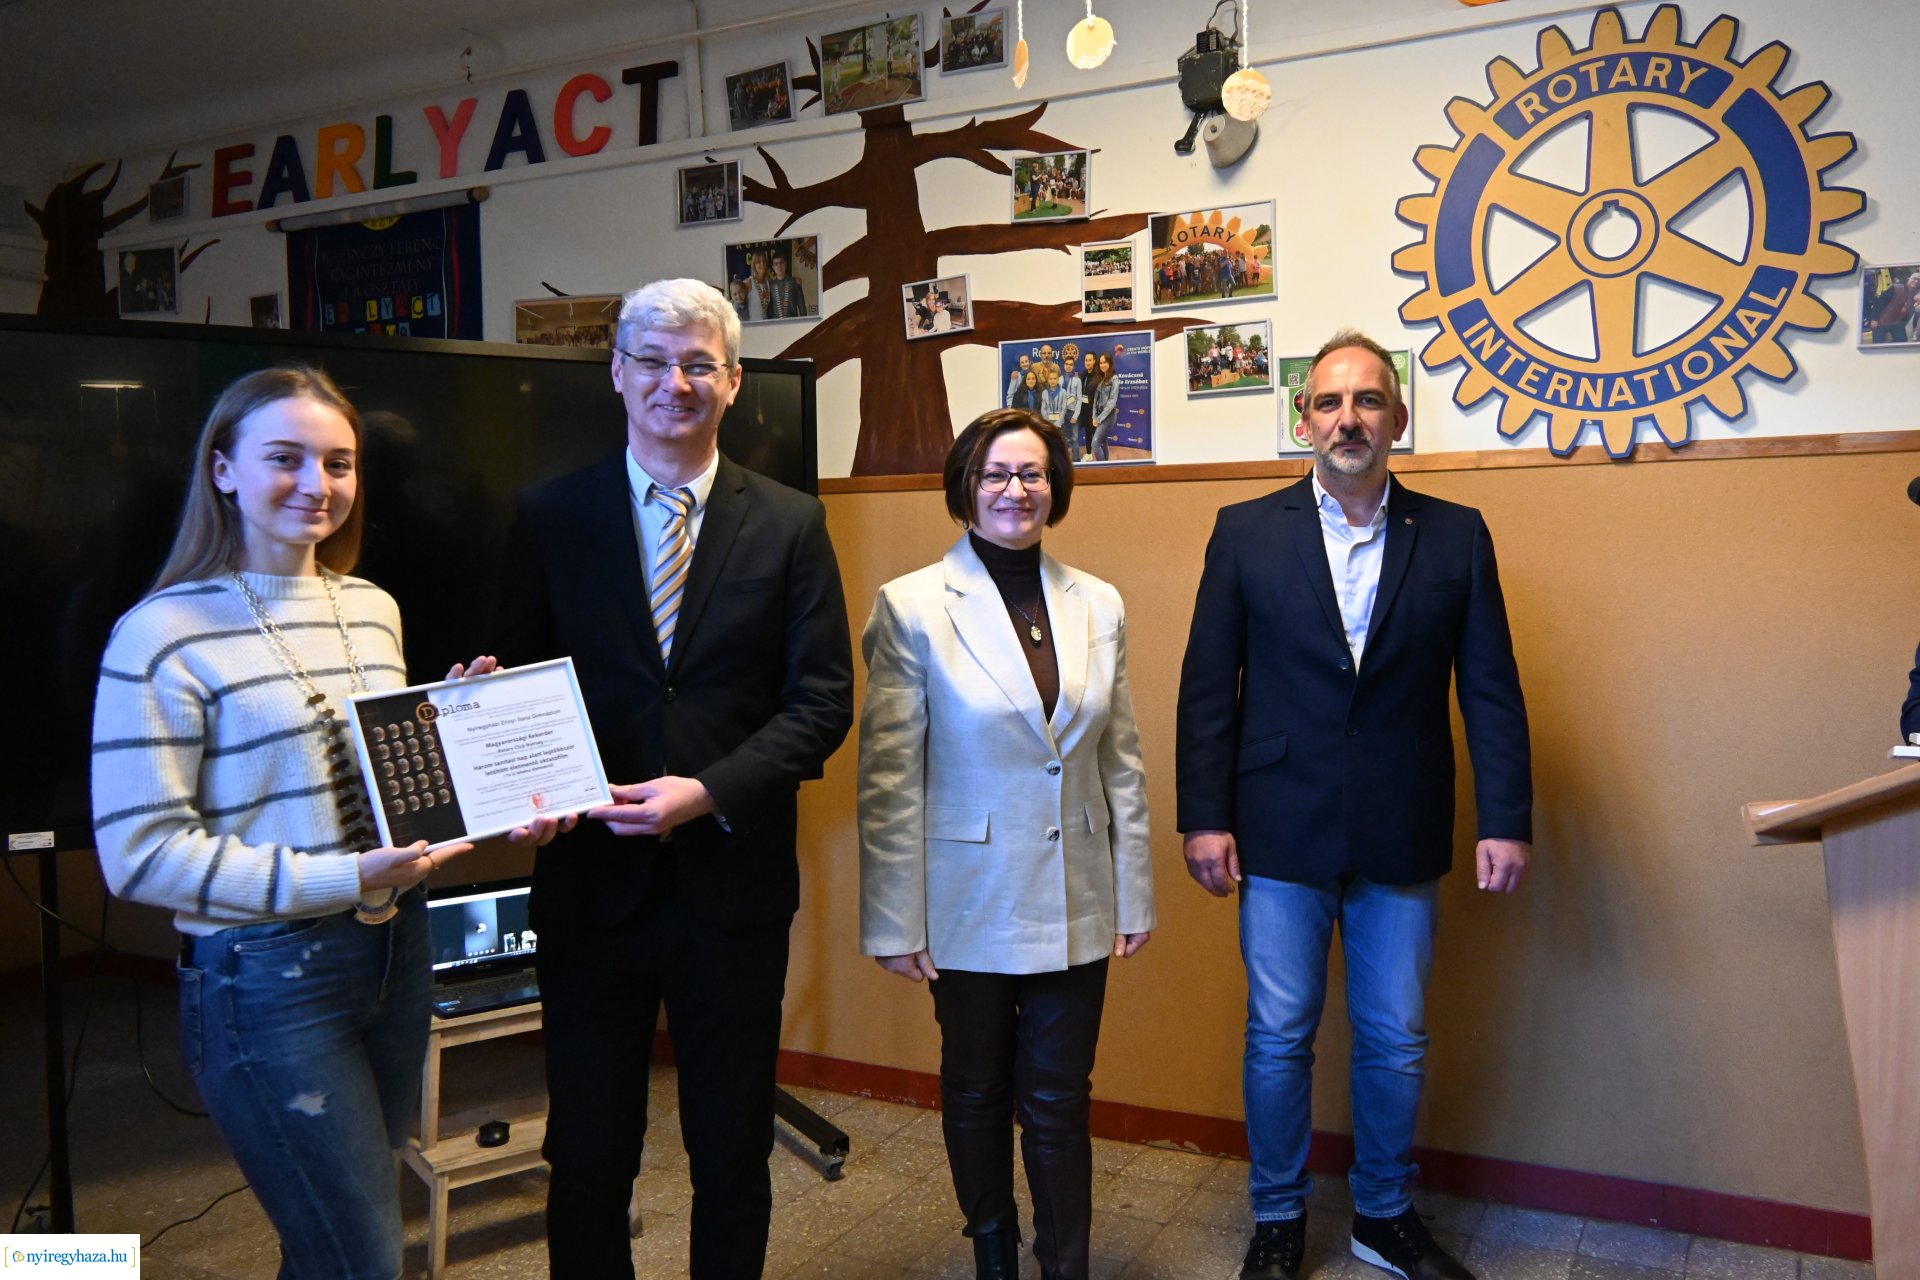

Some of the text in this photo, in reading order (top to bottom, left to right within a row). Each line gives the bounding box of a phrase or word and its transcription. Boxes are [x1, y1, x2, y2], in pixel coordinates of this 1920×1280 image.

[1515, 55, 1709, 126] ROTARY
[211, 60, 679, 218] EARLYACT
[389, 238, 441, 255] FERENC
[325, 293, 440, 324] EALYACT
[1032, 347, 1060, 360] Rory
[1462, 286, 1787, 408] INTERNATIONAL
[421, 702, 480, 719] Dploma
